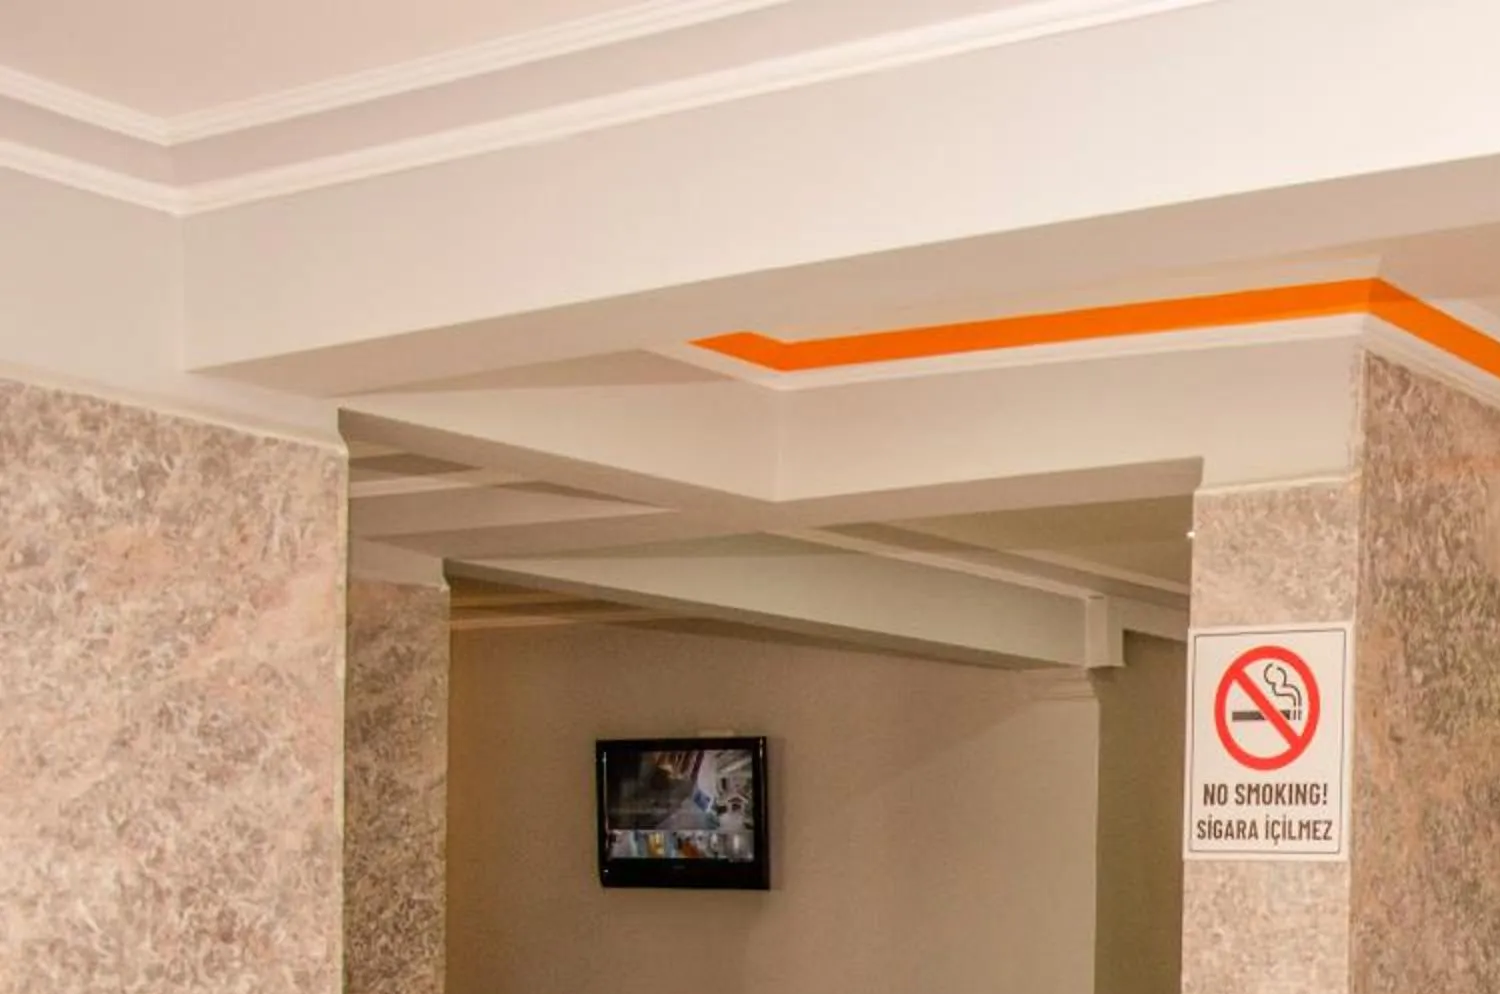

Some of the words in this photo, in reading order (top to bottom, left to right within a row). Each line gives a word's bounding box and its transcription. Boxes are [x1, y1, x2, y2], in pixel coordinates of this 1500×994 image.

[1203, 783, 1228, 806] NO
[1234, 783, 1328, 806] SMOKING!
[1197, 814, 1259, 841] SİGARA
[1265, 814, 1333, 846] İÇİLMEZ
